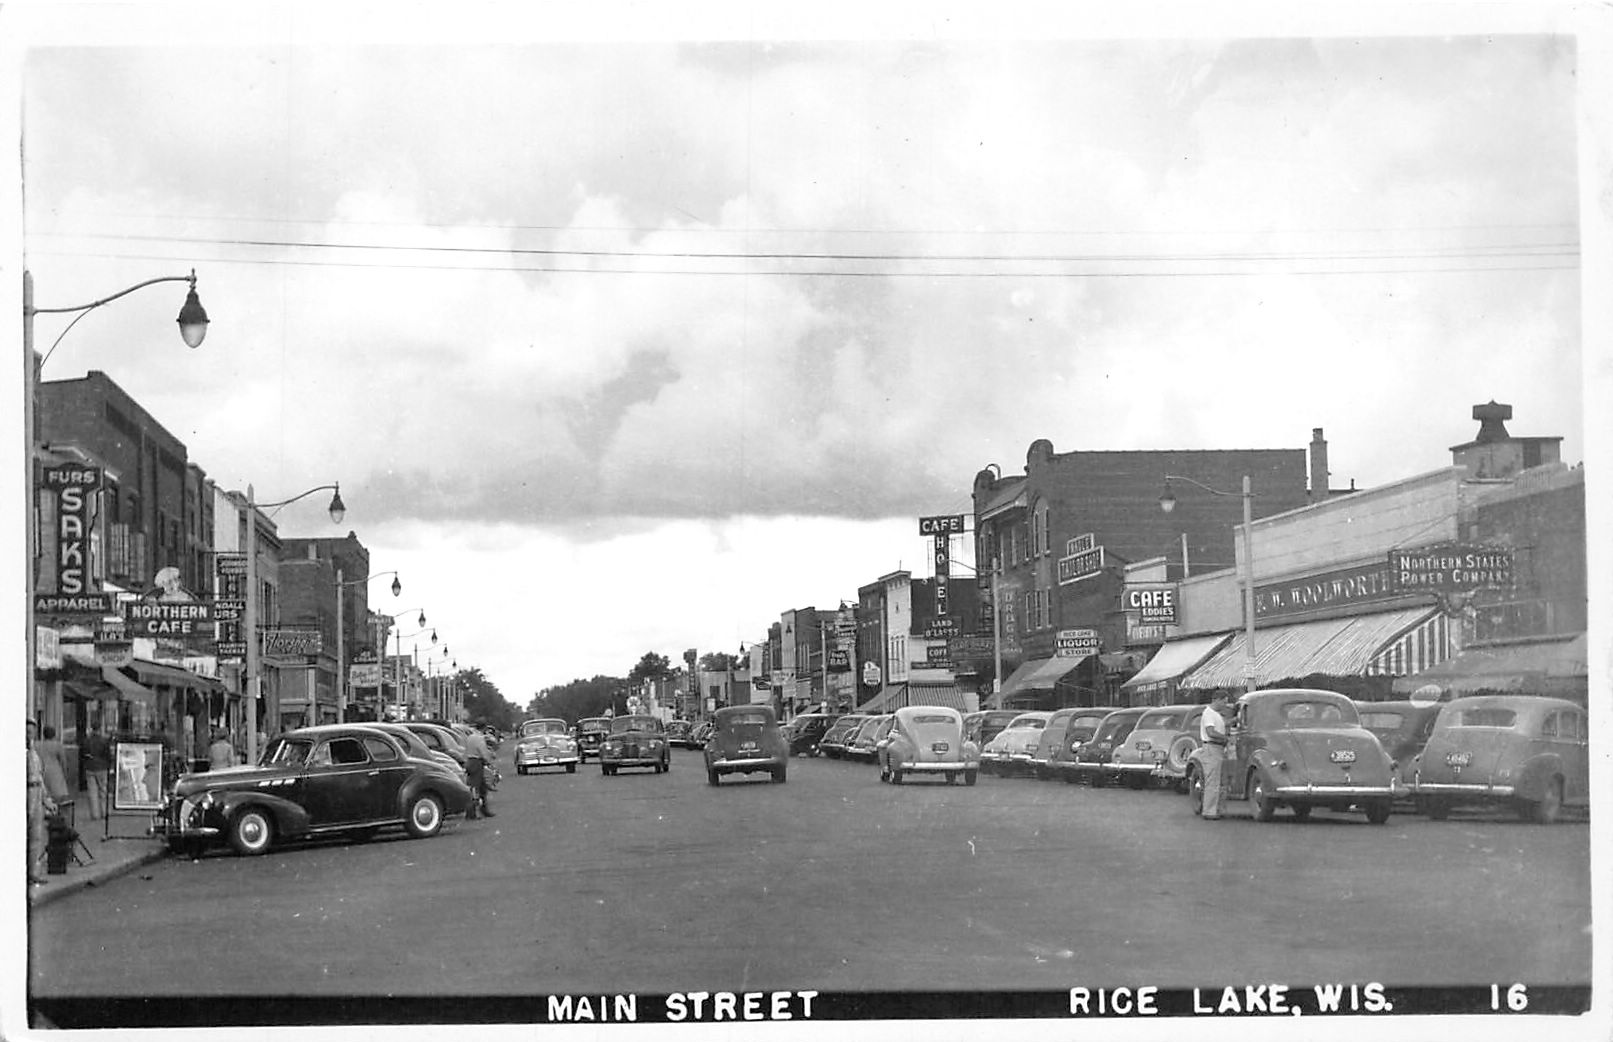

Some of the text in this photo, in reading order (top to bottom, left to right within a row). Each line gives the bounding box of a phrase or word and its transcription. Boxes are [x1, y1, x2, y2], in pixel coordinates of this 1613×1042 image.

[49, 471, 95, 483] FURS
[922, 519, 958, 531] CAFE
[61, 487, 82, 594] SAKS
[936, 537, 946, 615] HOEL
[36, 598, 106, 610] APPAREL
[1130, 591, 1172, 607] CAFE
[132, 605, 208, 618] NORTHERN
[215, 602, 243, 610] NDALL
[214, 610, 238, 619] URS
[147, 621, 191, 633] CAFE
[1057, 638, 1099, 648] LIQUOR
